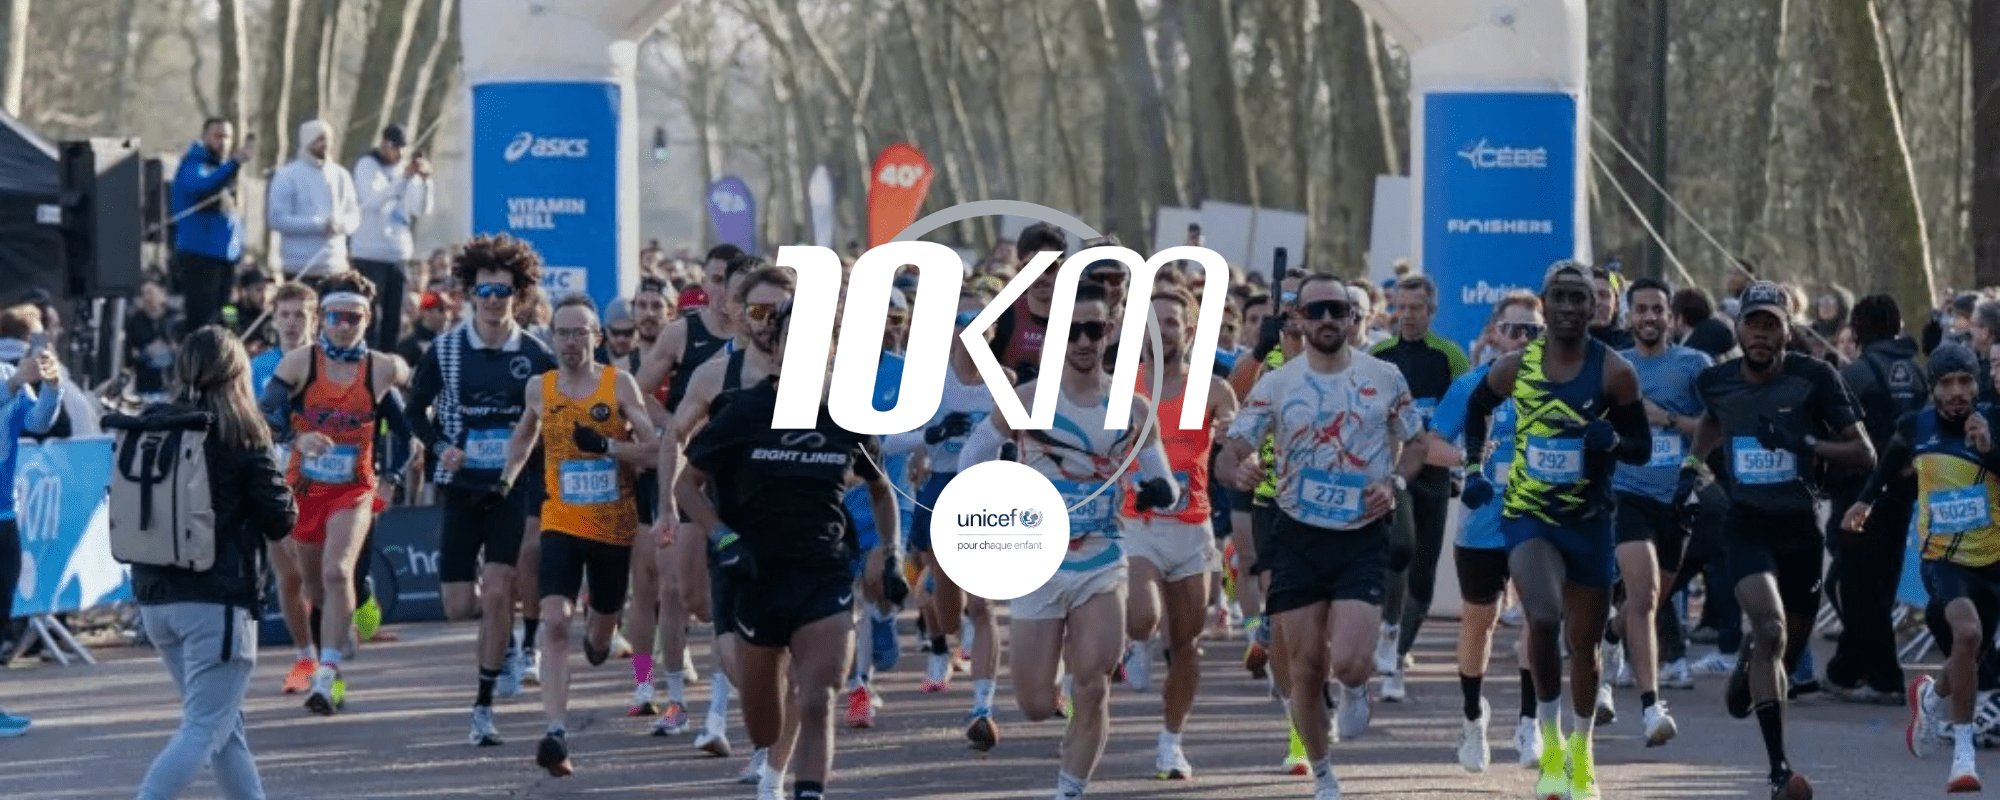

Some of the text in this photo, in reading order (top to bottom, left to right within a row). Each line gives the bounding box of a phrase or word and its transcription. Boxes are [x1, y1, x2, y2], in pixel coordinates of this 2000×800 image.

[531, 137, 588, 157] asics
[507, 198, 587, 214] VITAMIN
[508, 214, 556, 229] WELL
[1447, 219, 1554, 234] FINISHERS
[751, 448, 848, 464] EIGHT LINES
[1537, 451, 1566, 469] 292
[1744, 451, 1784, 469] 5697
[571, 474, 609, 491] 3109
[1315, 485, 1347, 506] 273
[1938, 501, 1978, 519] 6025
[382, 544, 440, 575] Chr
